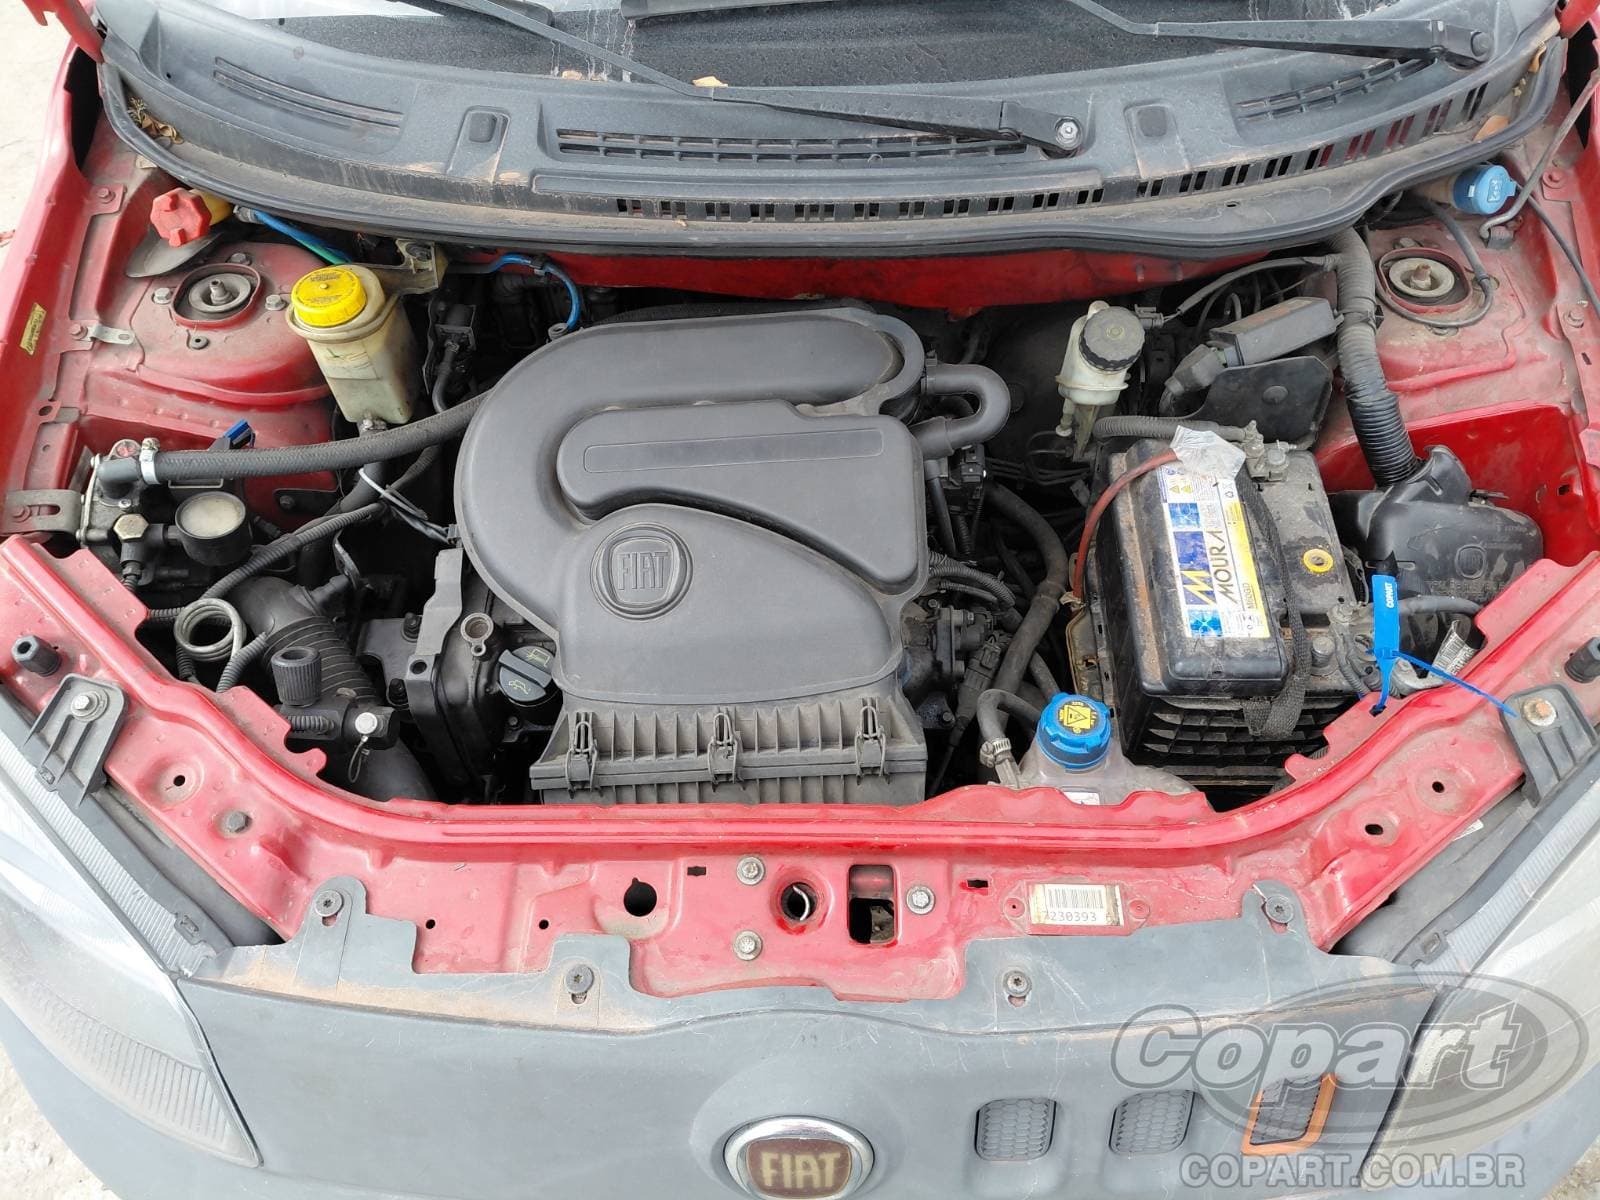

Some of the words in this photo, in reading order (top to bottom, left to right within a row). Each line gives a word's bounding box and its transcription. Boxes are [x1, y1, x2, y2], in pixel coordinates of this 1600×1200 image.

[617, 551, 669, 591] FIAT
[1209, 530, 1238, 604] MOURA
[761, 1151, 841, 1189] FIAT
